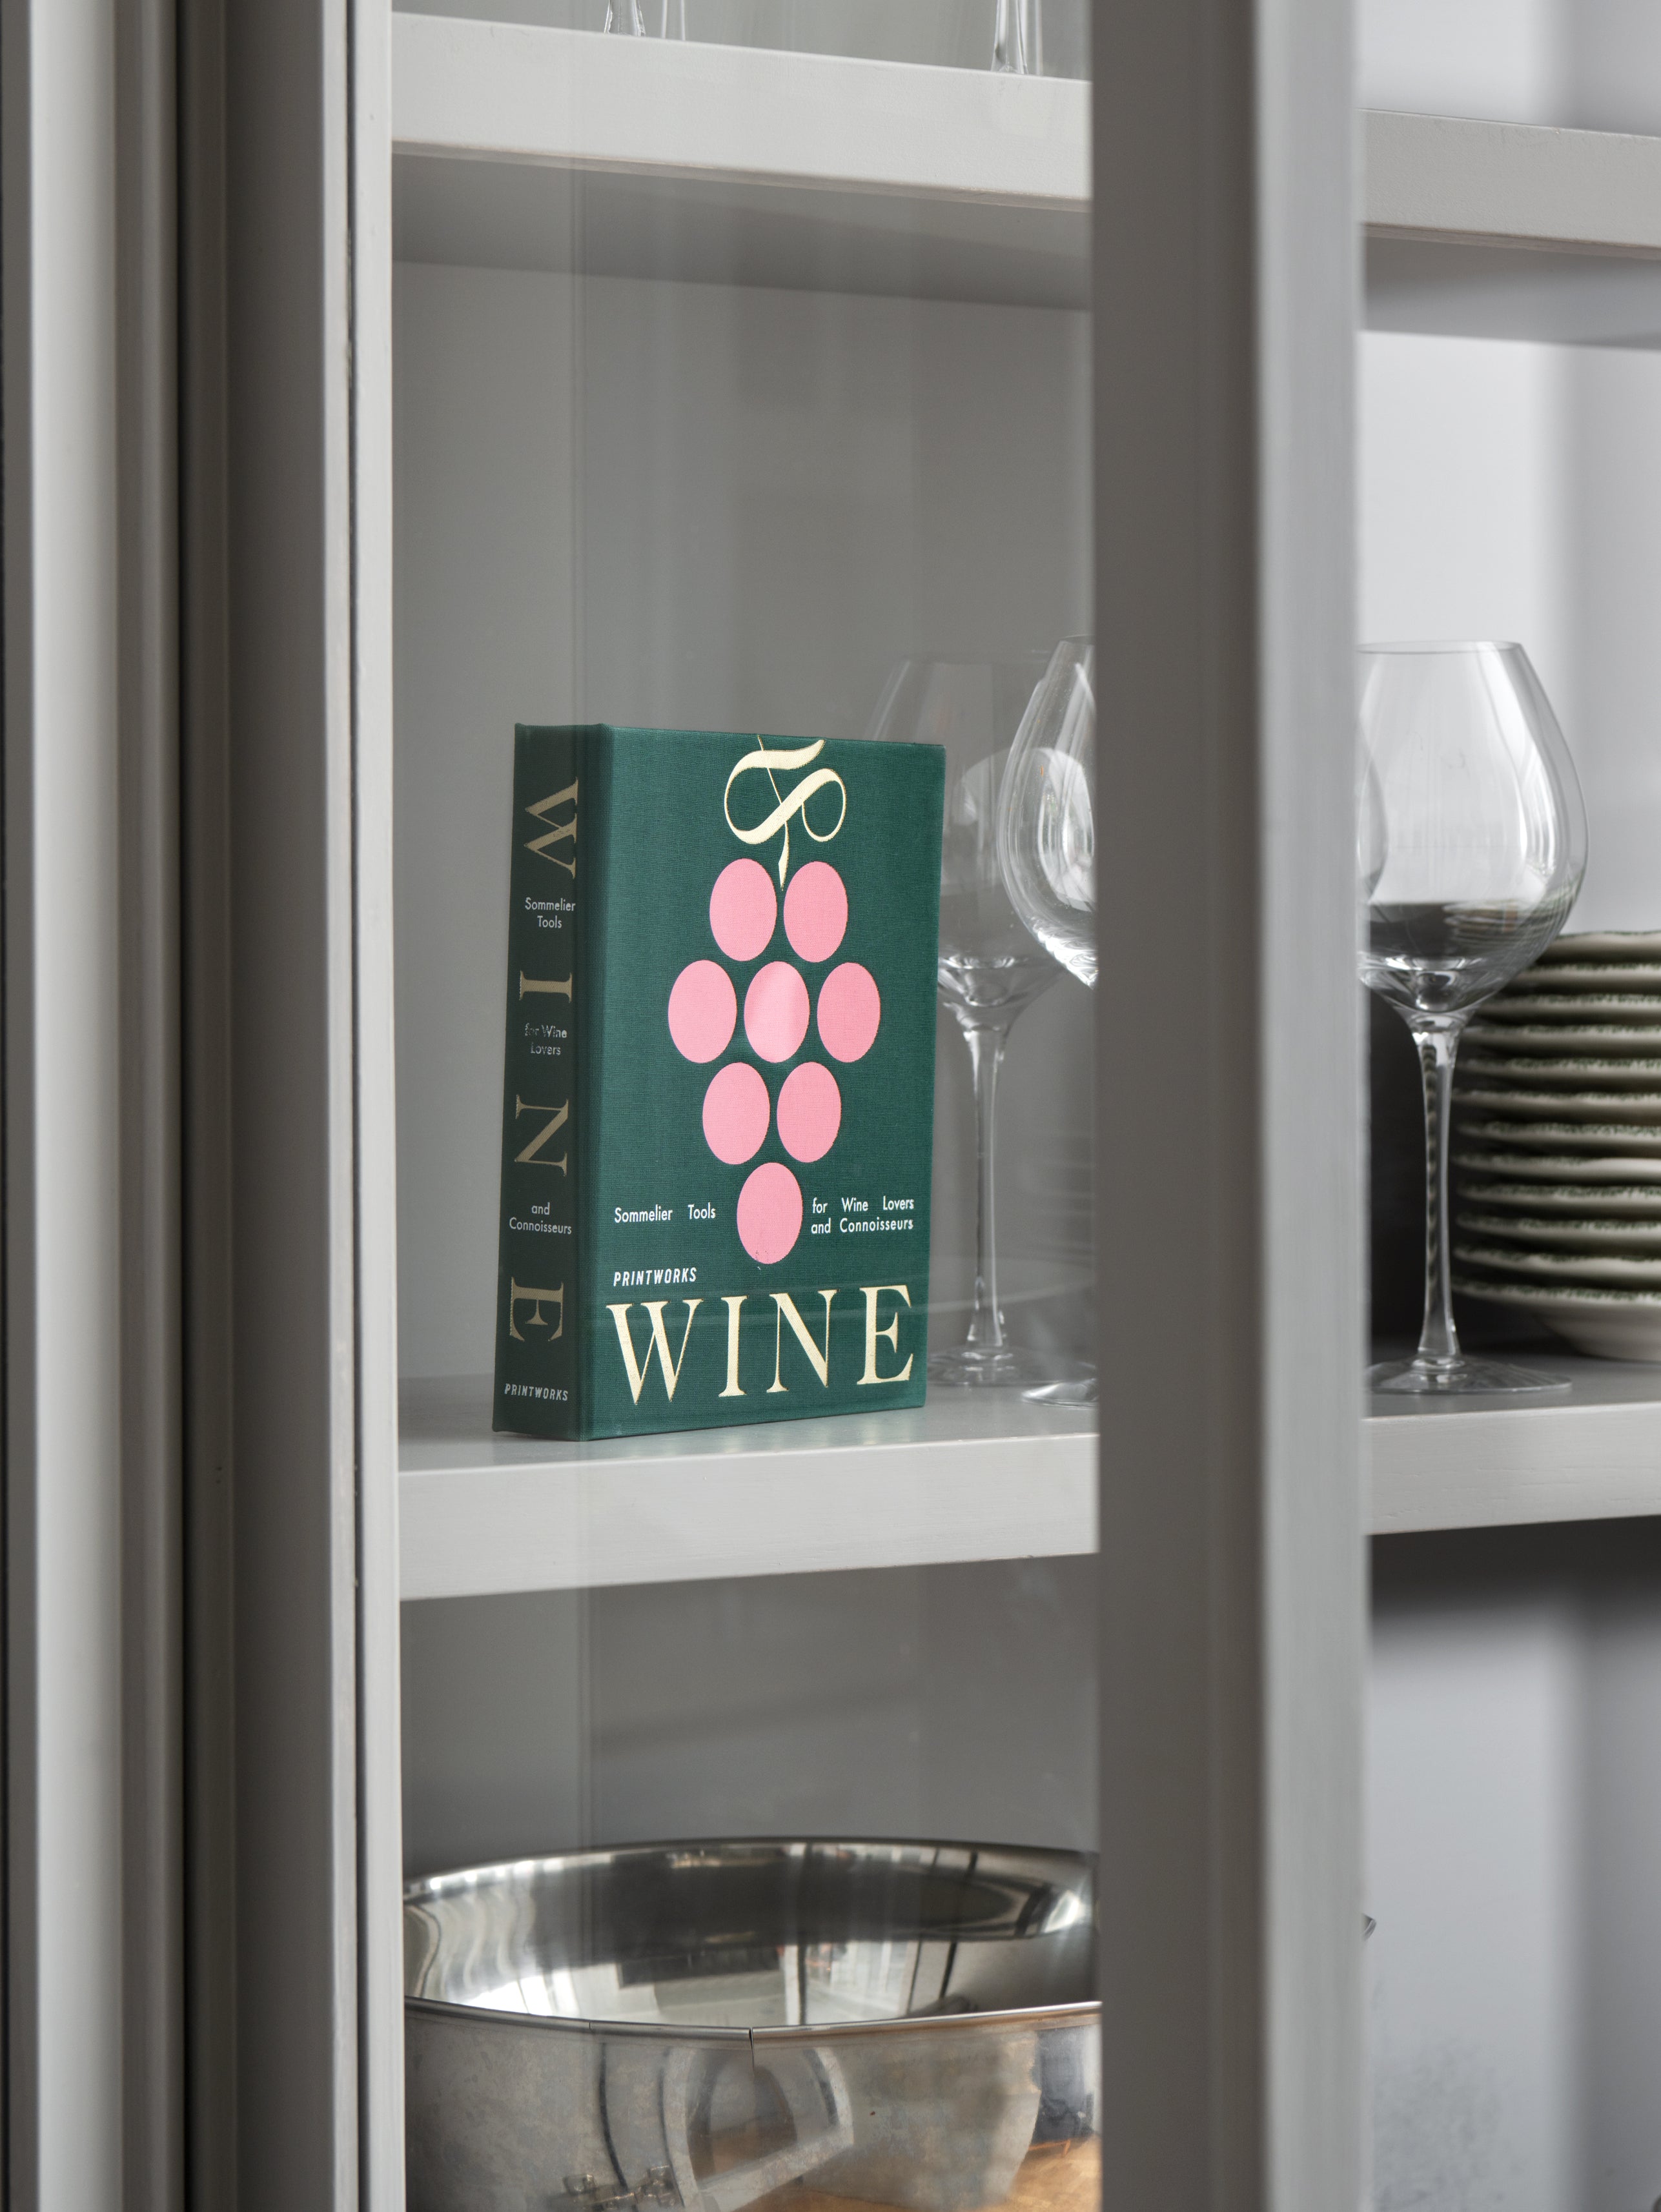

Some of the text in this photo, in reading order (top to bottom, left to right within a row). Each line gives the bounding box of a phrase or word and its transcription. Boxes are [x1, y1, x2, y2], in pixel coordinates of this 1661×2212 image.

[524, 897, 576, 911] Sommelier
[536, 915, 562, 929] Tools
[541, 1025, 567, 1039] Wine
[530, 1043, 561, 1056] Lovers
[531, 1202, 550, 1215] and
[812, 1195, 915, 1213] for Wine Lovers
[614, 1202, 716, 1223] Sommelier Tools
[509, 1217, 572, 1234] Connoisseurs
[811, 1217, 914, 1233] and Connoisseurs
[613, 1267, 697, 1286] PRINTWORKS
[606, 1284, 914, 1405] WINE
[504, 1383, 568, 1401] PRINTWORKS
